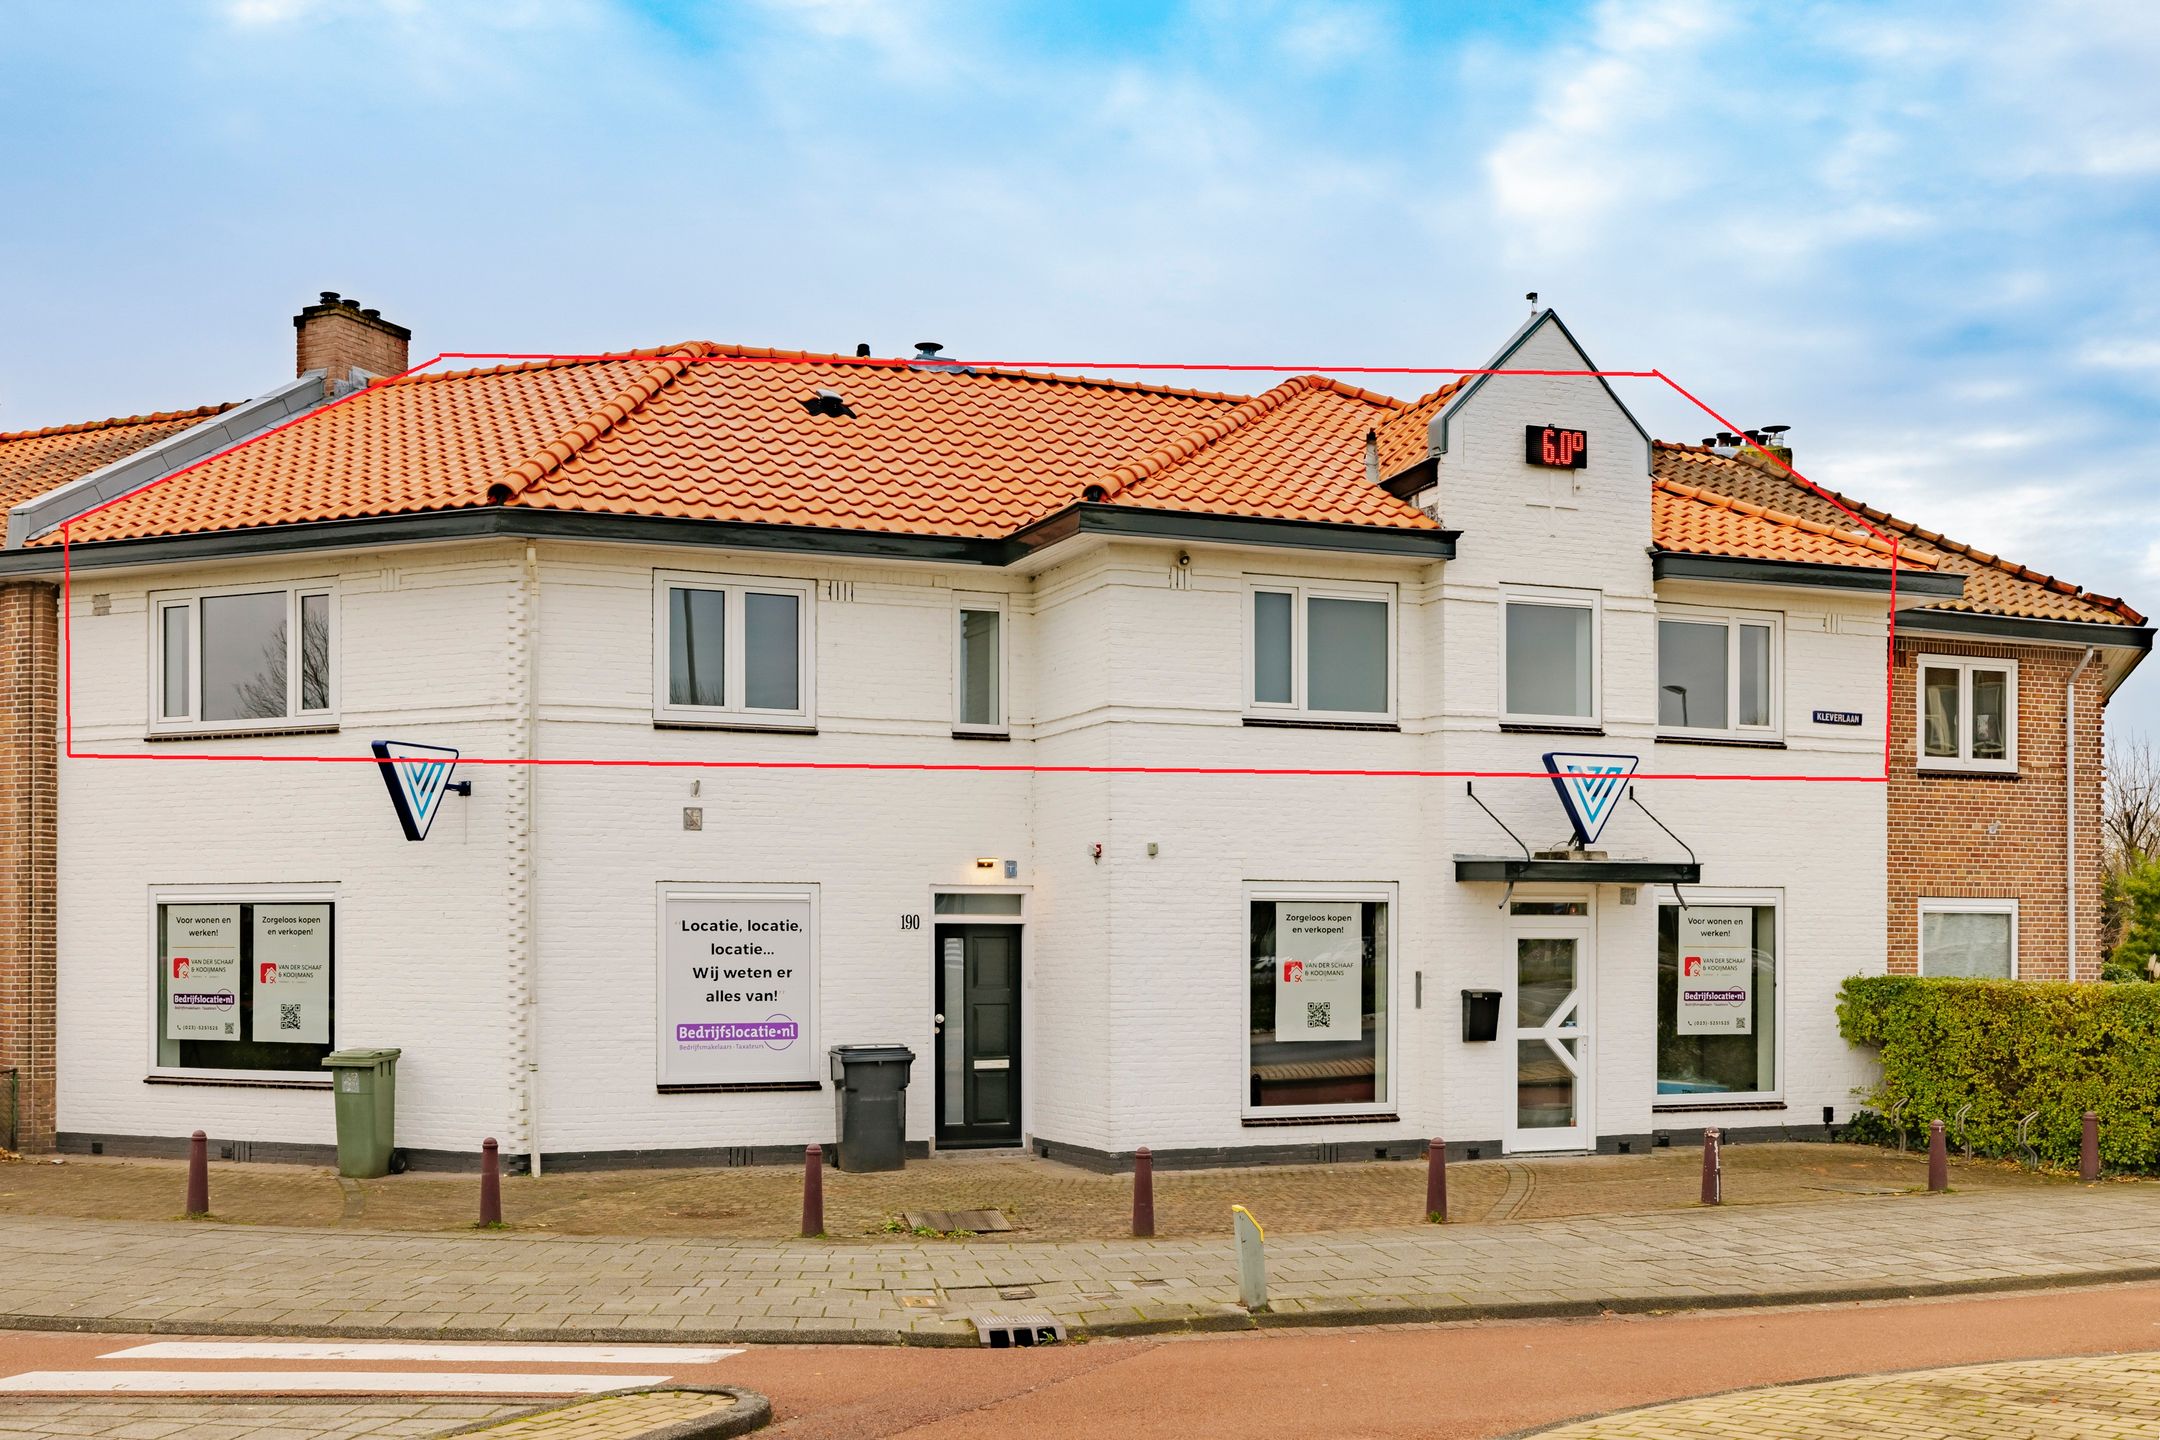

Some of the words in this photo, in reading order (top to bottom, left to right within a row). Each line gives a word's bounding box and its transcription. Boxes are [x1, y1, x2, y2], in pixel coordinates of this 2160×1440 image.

[1817, 713, 1860, 723] KLEVERLAAN
[262, 916, 297, 924] Zorgeloos
[298, 916, 321, 924] kopen
[900, 914, 920, 930] 190
[1286, 914, 1325, 922] Zorgeloos
[1328, 914, 1352, 923] kopen
[748, 920, 803, 933] locatie,
[1304, 926, 1344, 935] verkopen!
[189, 929, 219, 937] werken!
[278, 928, 313, 936] verkopen!
[711, 943, 774, 955] locatie...
[693, 967, 719, 981] Wij
[723, 968, 772, 978] weten
[777, 969, 793, 978] er
[706, 991, 741, 1002] alles
